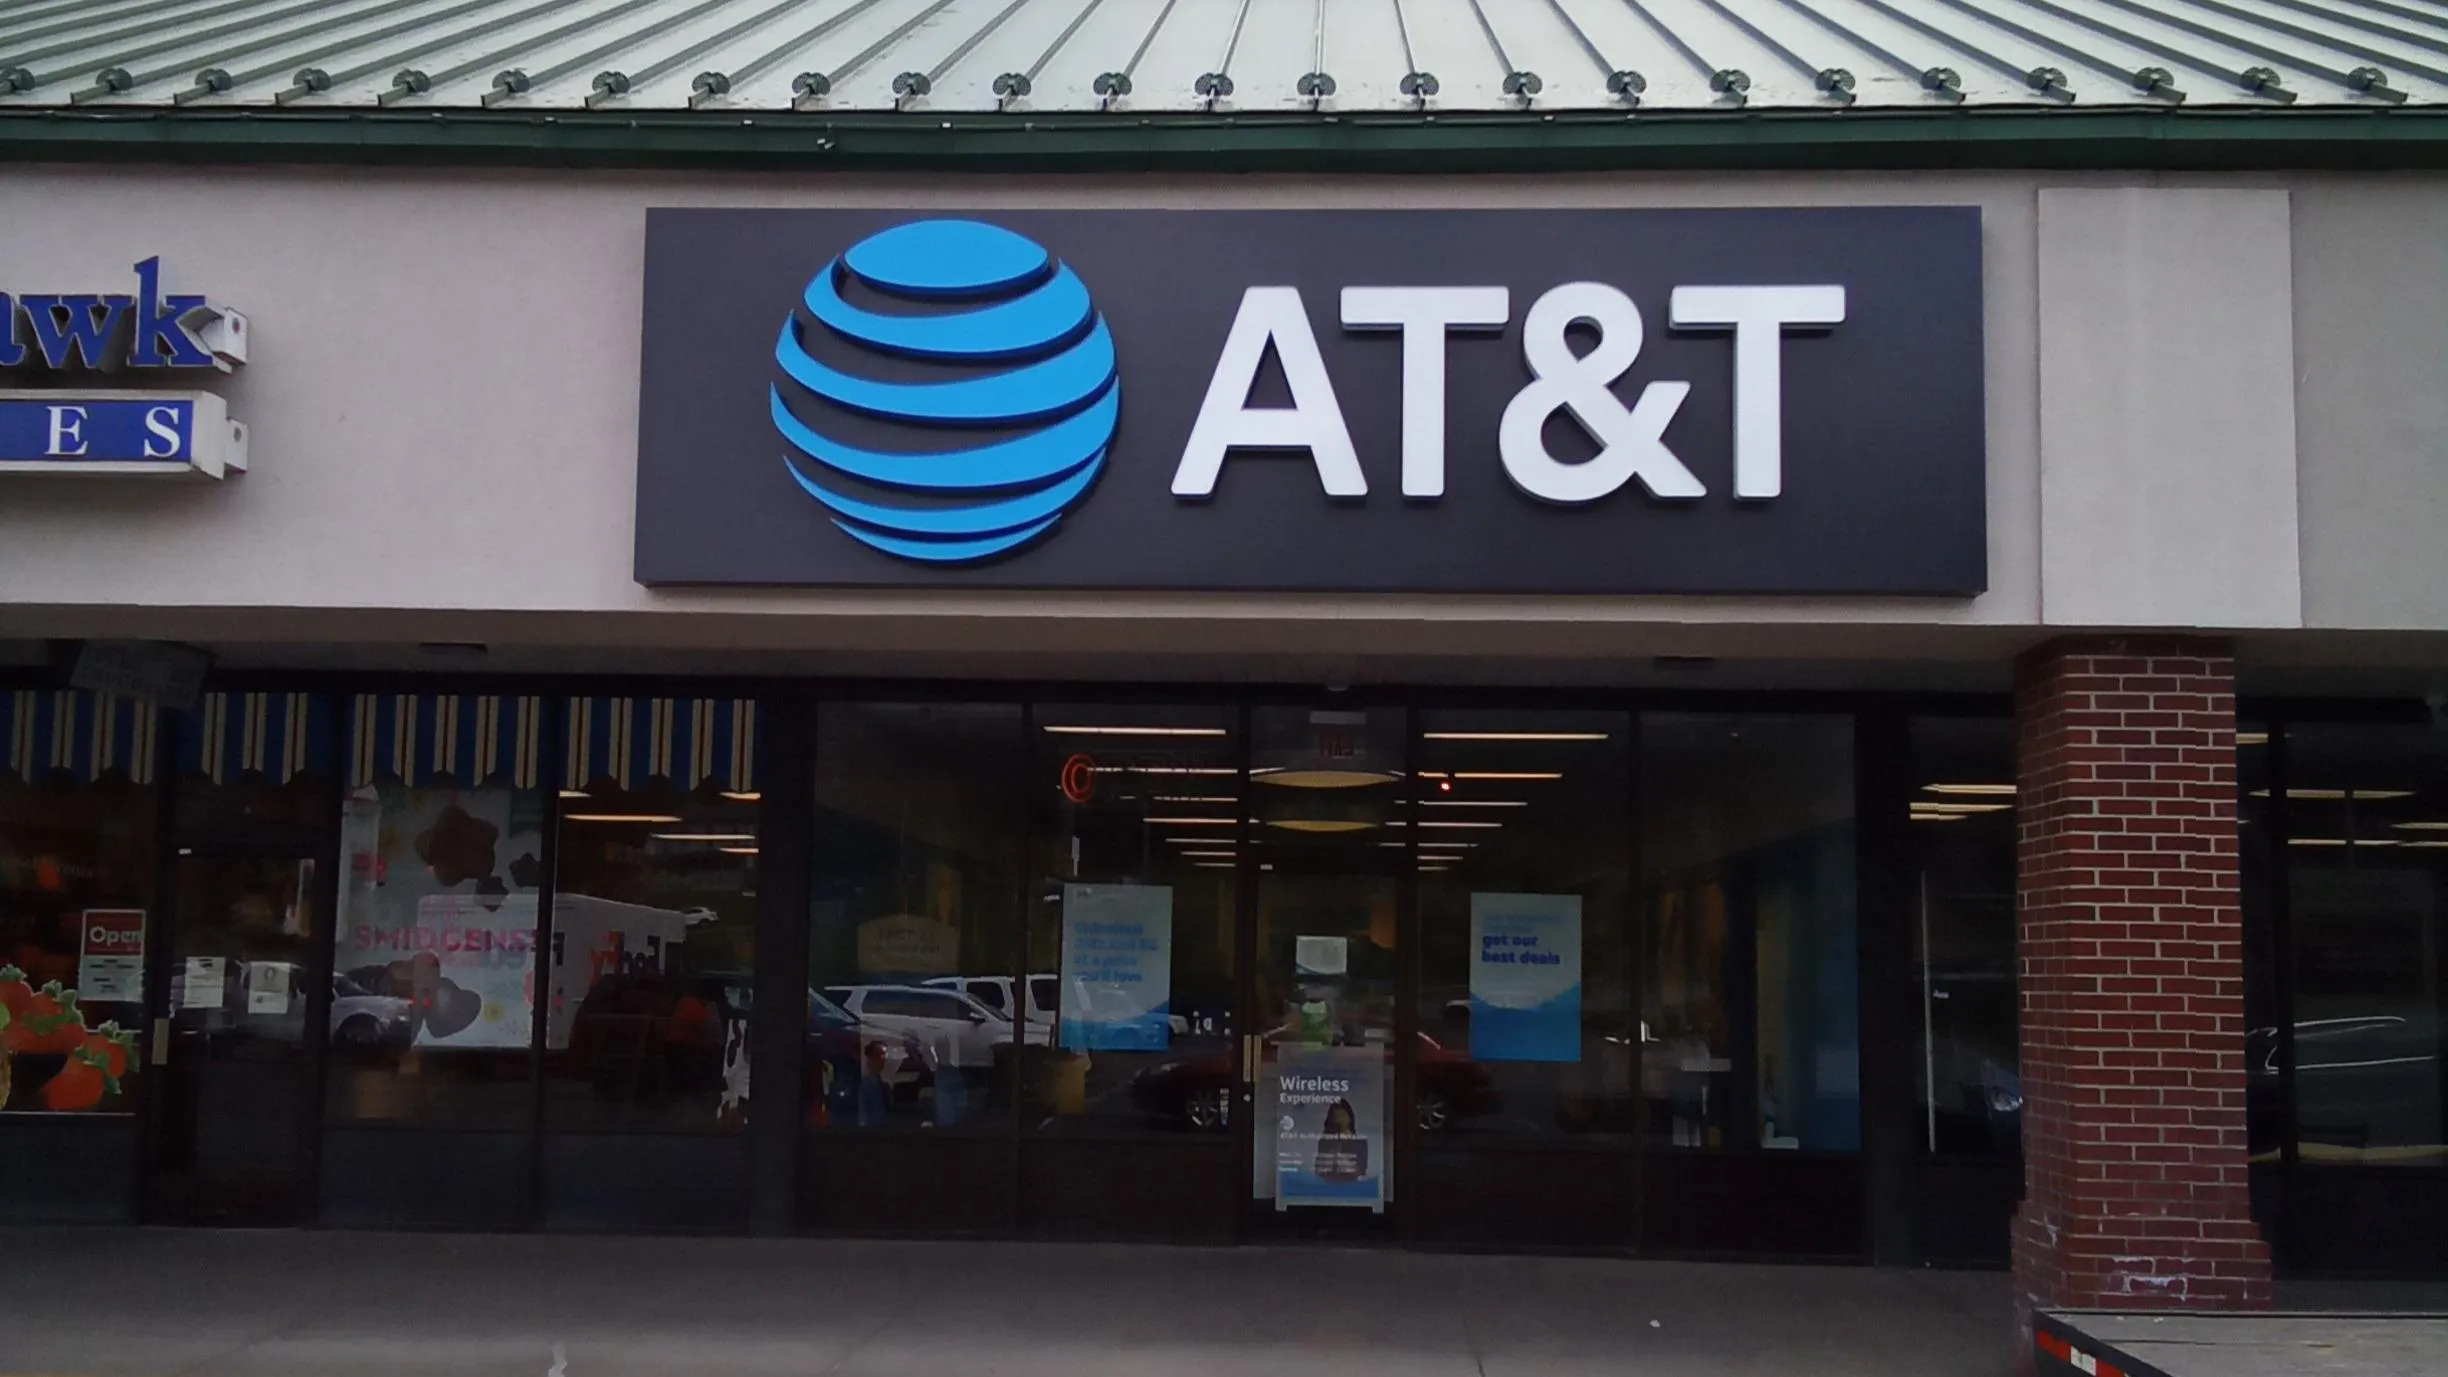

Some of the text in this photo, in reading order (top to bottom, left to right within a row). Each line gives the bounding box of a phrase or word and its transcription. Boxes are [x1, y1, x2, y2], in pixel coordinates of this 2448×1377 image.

[1170, 281, 1846, 502] AT&T
[90, 926, 142, 947] Open
[1482, 935, 1539, 948] get our
[1481, 949, 1561, 965] best deals
[1279, 1076, 1350, 1092] Wireless
[1279, 1093, 1342, 1106] Experience
